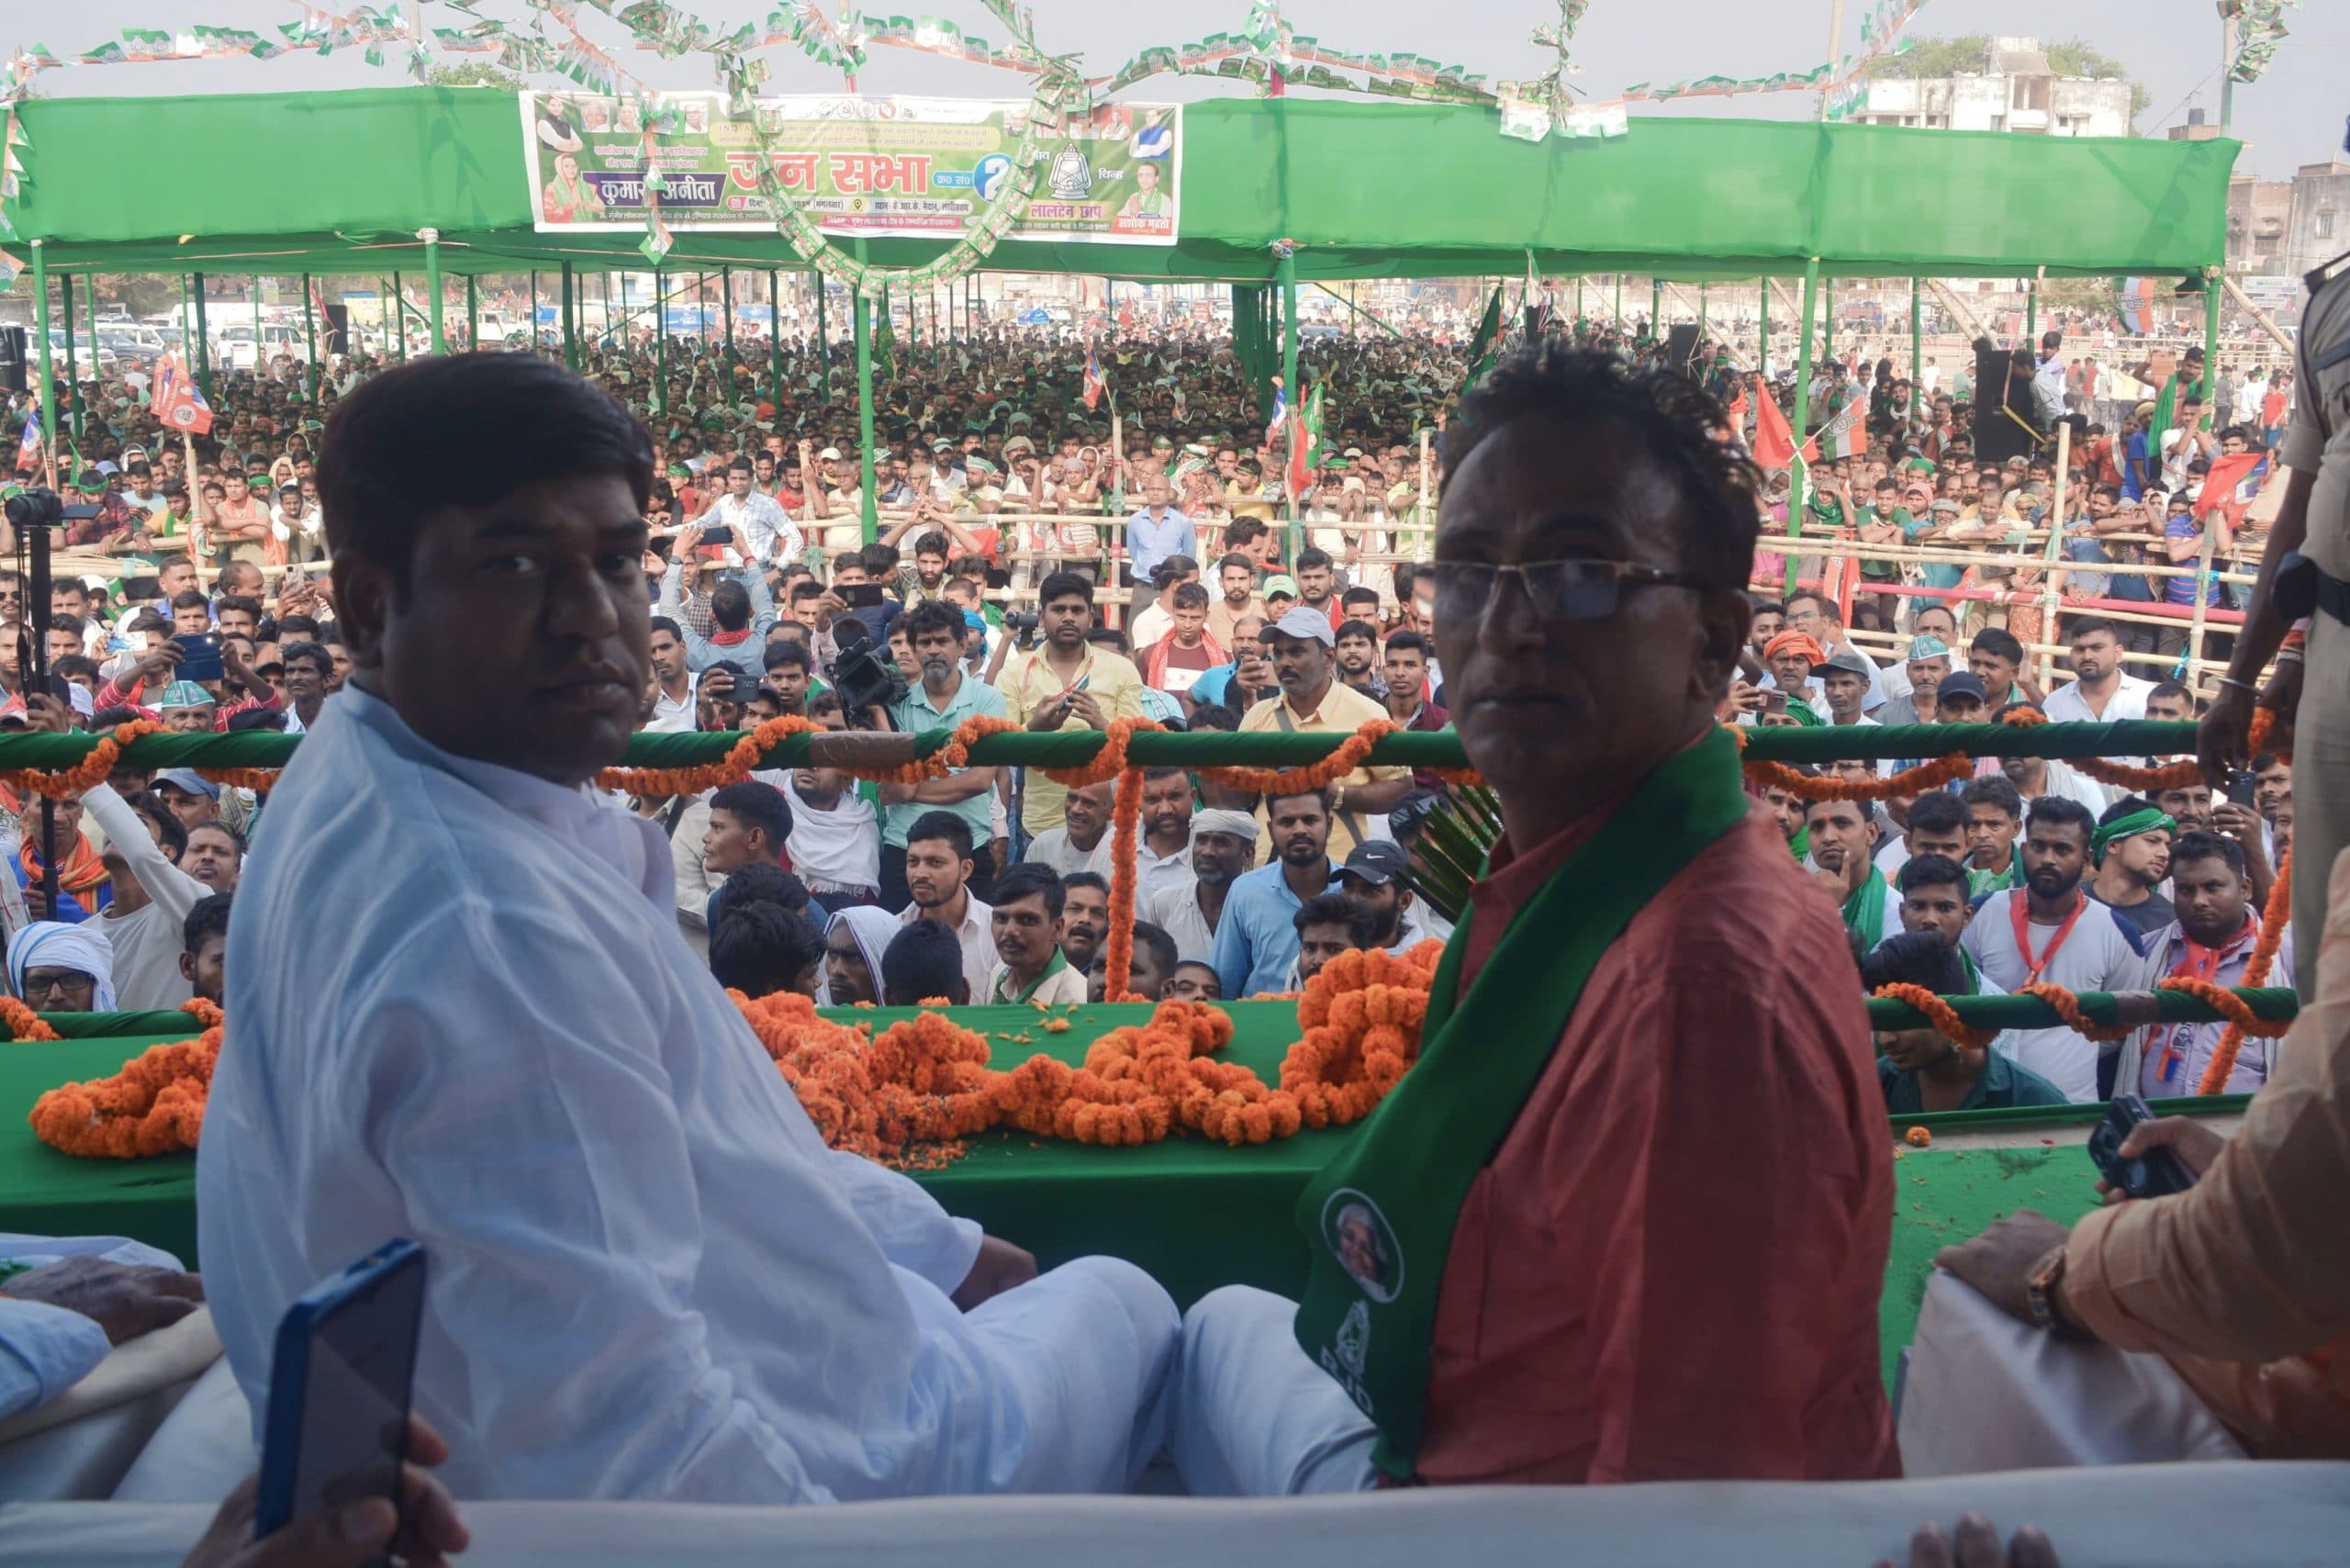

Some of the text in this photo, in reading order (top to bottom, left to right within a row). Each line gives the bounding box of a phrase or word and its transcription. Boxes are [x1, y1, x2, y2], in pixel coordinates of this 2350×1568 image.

[829, 153, 931, 195] सभा
[661, 175, 715, 200] अनीता
[1030, 202, 1102, 218] लालटेन छाप
